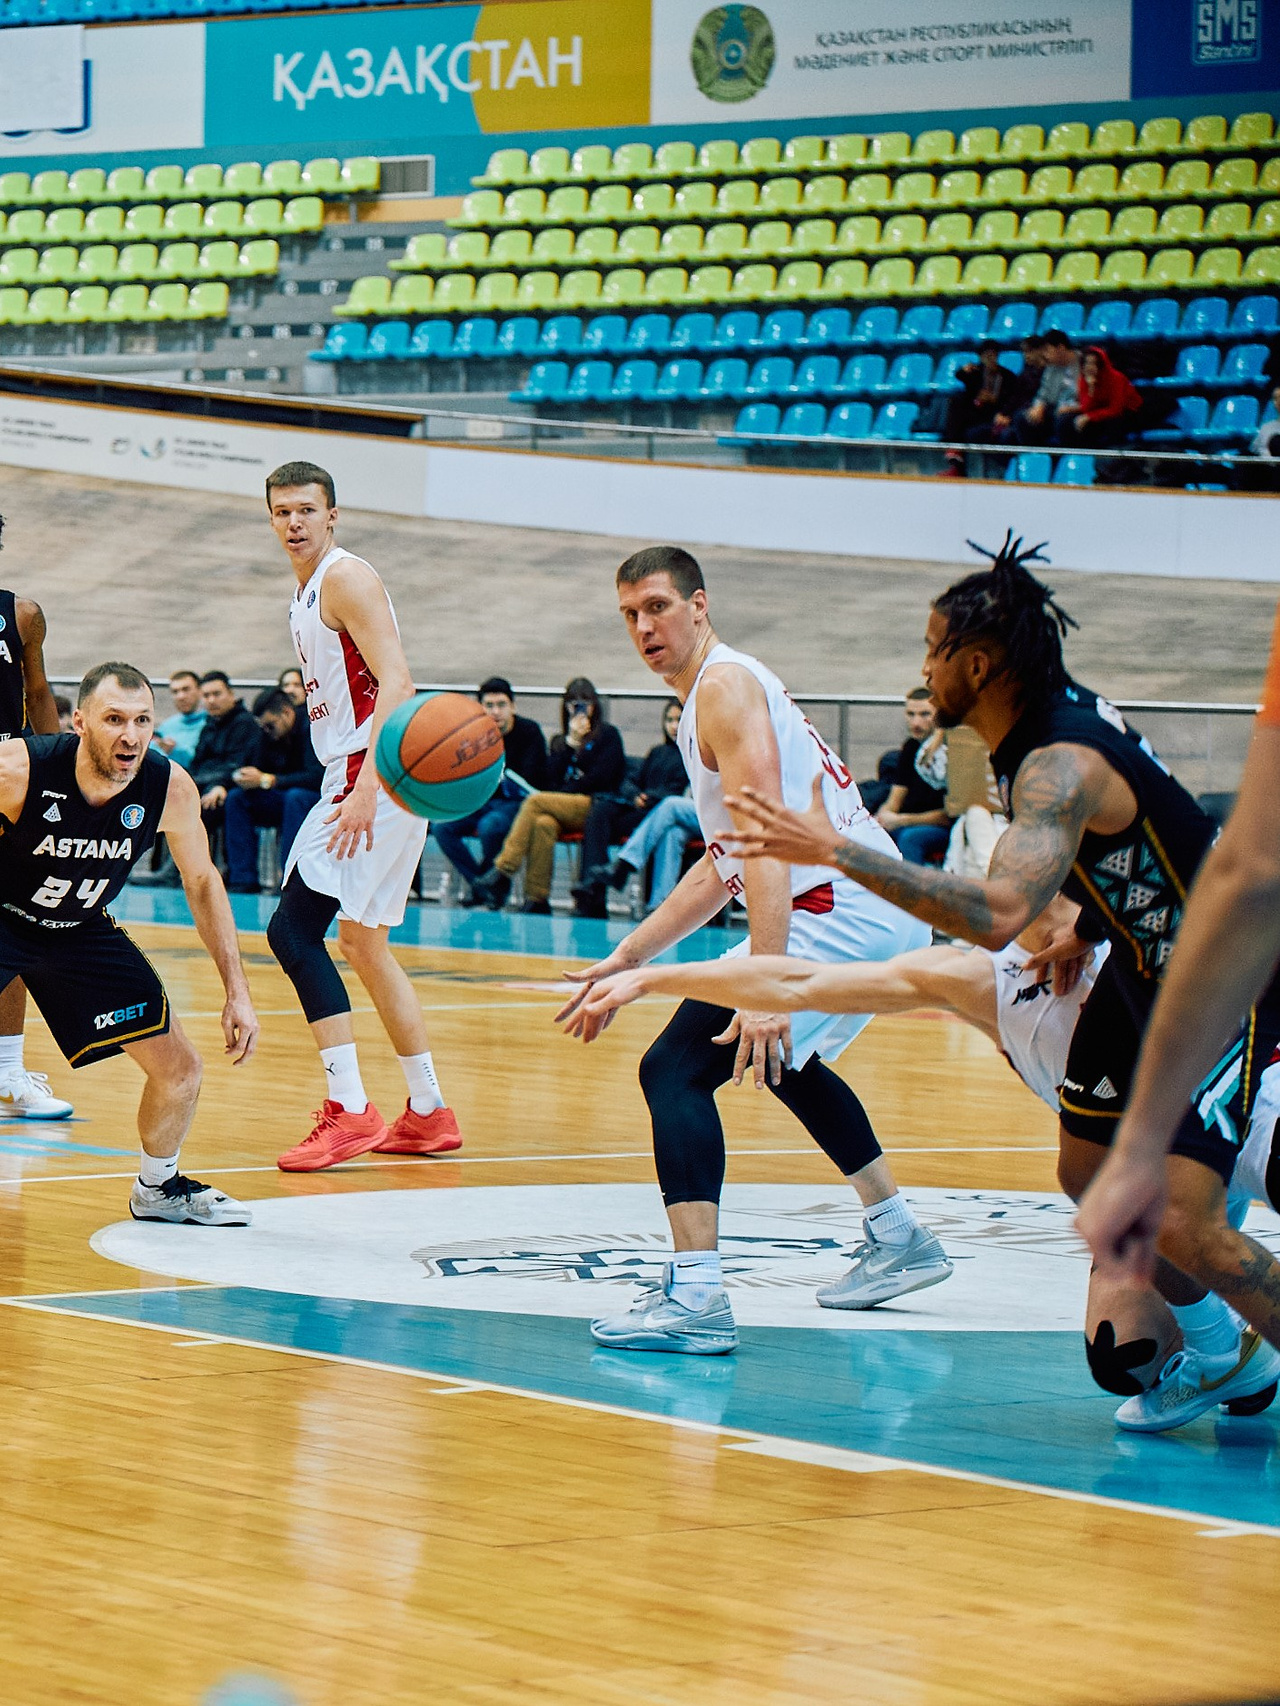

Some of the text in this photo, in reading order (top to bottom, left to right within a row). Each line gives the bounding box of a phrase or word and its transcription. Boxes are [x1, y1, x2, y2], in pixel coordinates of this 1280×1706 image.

[1198, 0, 1256, 42] SMS
[273, 36, 583, 110] ҚАЗАҚСТАН
[32, 834, 132, 861] ASTANA
[31, 875, 110, 909] 24
[93, 1002, 148, 1030] 1XBET
